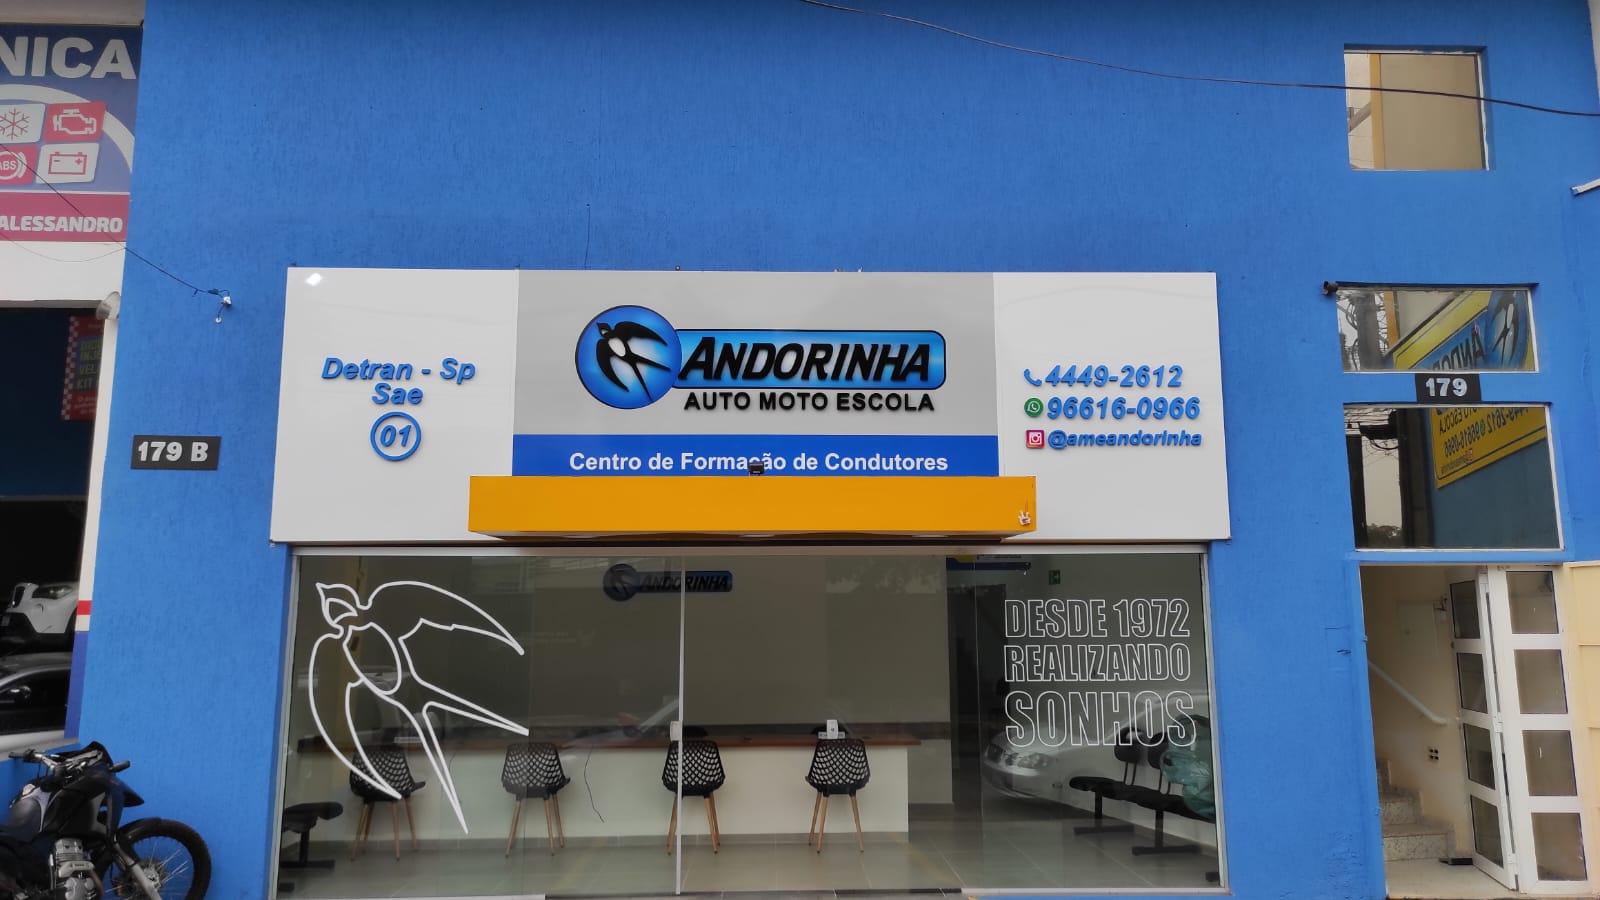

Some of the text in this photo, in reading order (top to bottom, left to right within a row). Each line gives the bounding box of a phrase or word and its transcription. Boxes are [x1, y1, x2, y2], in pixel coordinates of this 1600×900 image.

[0, 215, 123, 233] ALESSANDRO
[678, 336, 931, 381] ANDORINHA
[321, 357, 413, 380] Detran
[439, 357, 476, 385] Sp
[1045, 365, 1183, 387] 4449-2612
[371, 382, 424, 405] Sae
[1425, 377, 1468, 397] 179
[684, 392, 935, 411] AUTO MOTO ESCOLA
[1047, 396, 1200, 419] 96616-0966
[380, 424, 412, 447] 01
[1048, 430, 1202, 450] @ameandorinha
[138, 441, 209, 462] 179 B
[569, 453, 642, 471] Centro
[648, 453, 673, 471] de
[793, 453, 818, 471] de
[824, 453, 949, 472] Condutores
[1004, 599, 1190, 638] DESDE 1972
[1004, 643, 1191, 682] REALIZANDO
[1004, 690, 1197, 747] SONHOS
